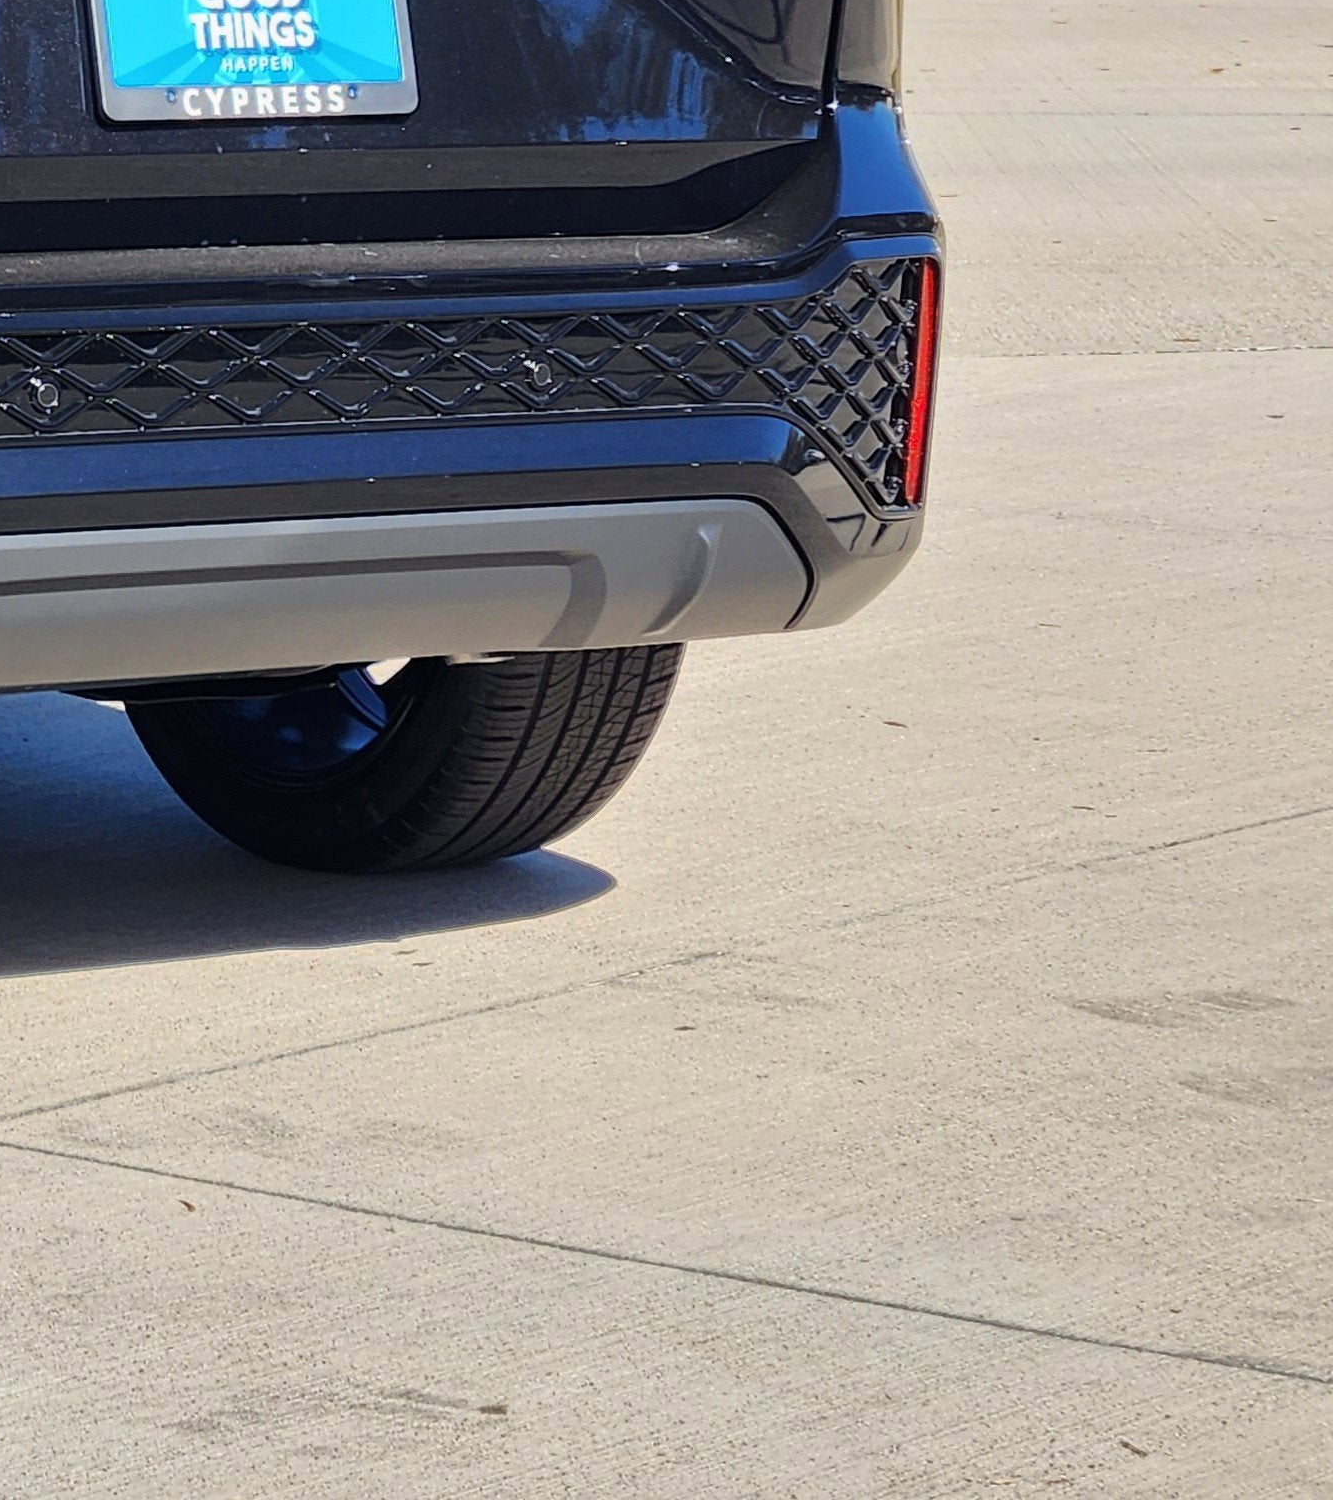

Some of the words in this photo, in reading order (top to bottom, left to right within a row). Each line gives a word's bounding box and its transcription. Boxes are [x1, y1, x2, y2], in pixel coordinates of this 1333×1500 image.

[188, 10, 316, 49] THINGS
[221, 55, 295, 72] HAPPEN
[183, 84, 346, 117] CYPRESS
